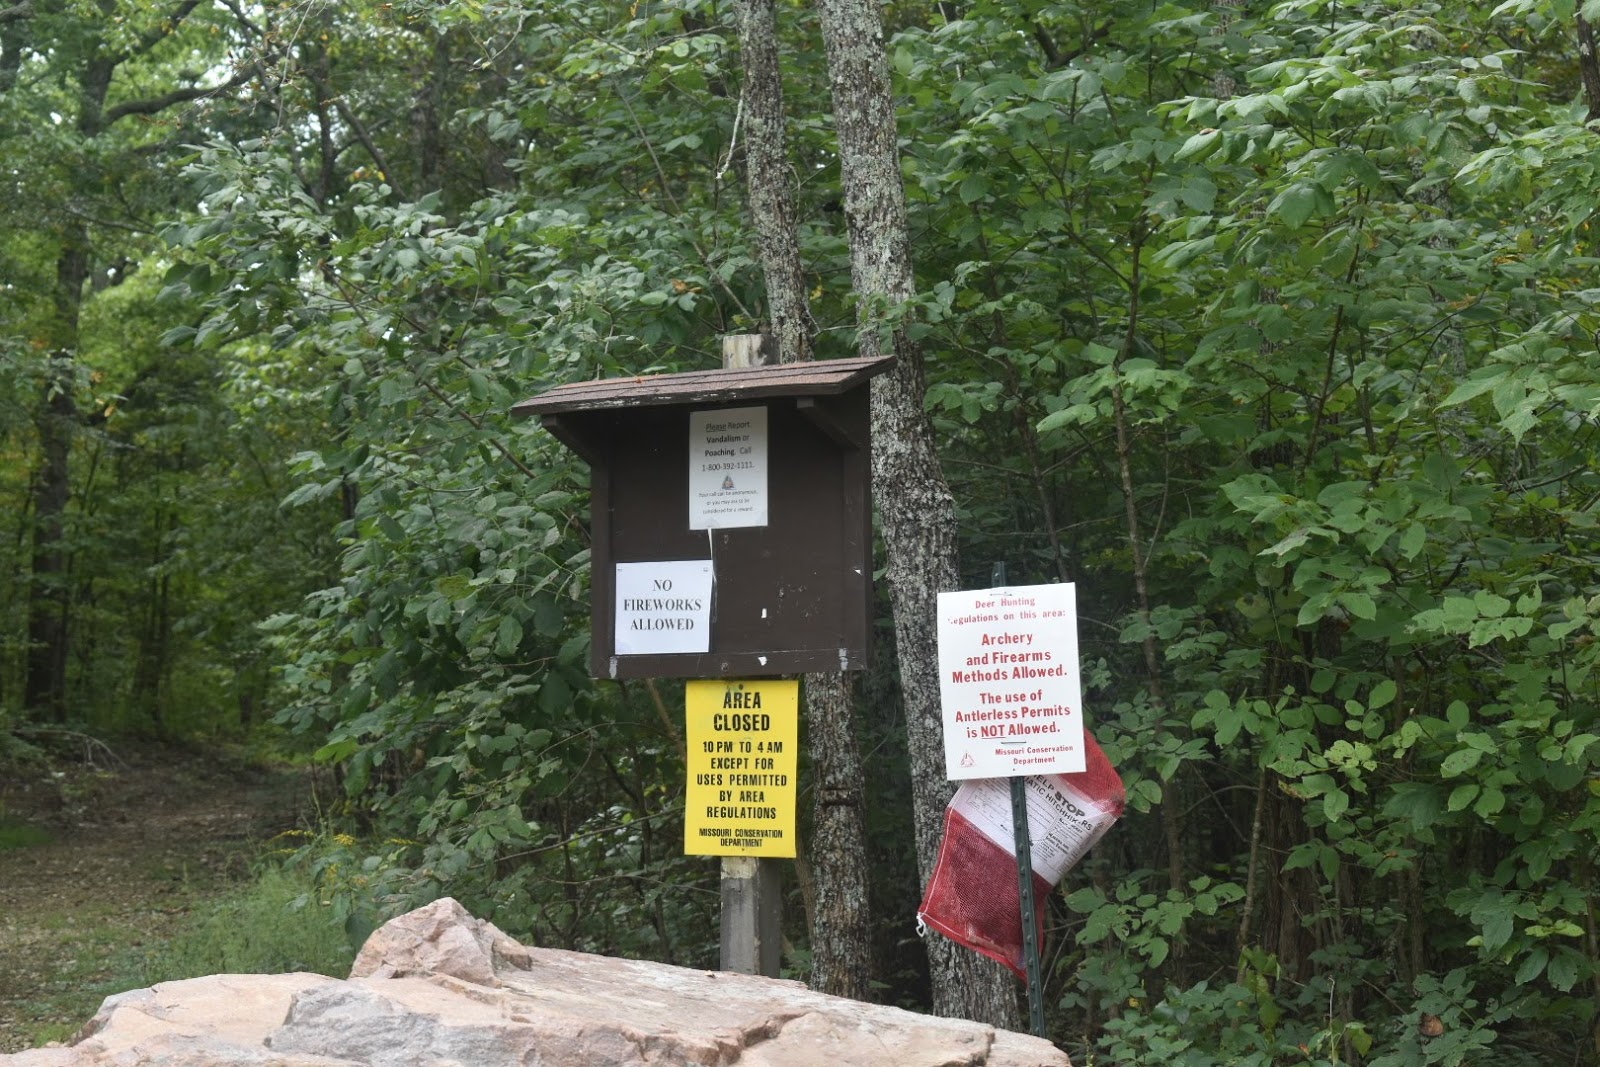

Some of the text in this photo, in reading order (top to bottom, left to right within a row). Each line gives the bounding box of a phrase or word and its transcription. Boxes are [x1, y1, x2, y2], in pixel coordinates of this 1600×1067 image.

[706, 421, 750, 432] Please Report
[706, 435, 741, 444] Vandalism
[740, 446, 752, 455] Call
[653, 579, 673, 592] NO
[623, 598, 702, 612] FIREWORKS
[975, 598, 1036, 609] Deer Hunting
[948, 610, 1066, 625] egulations on this area:
[630, 618, 694, 631] ALLOWED
[981, 632, 1033, 646] Archery
[966, 651, 1052, 666] and Firearms
[952, 664, 1068, 684] Methods Allowed.
[723, 691, 762, 709] AREA
[980, 689, 1042, 704] The use of
[955, 705, 1071, 723] Antlerless Permits
[713, 713, 770, 731] CLOSED
[967, 722, 1061, 738] is NOT Allowed.
[703, 741, 783, 753] 10 PM TO 4 AM
[995, 745, 1073, 756] Missouri Conservation
[711, 758, 774, 770] EXCEPT FOR
[1013, 756, 1056, 765] Department
[697, 773, 787, 786] USES PERMITTED
[719, 790, 765, 802] BY AREA
[1054, 791, 1086, 818] STOP
[707, 806, 777, 819] REGULATIONS
[1045, 793, 1093, 831] HITCHHIKRS
[699, 828, 783, 838] MISSOURI CONSERVATION
[720, 838, 763, 847] DEPARTMENT
